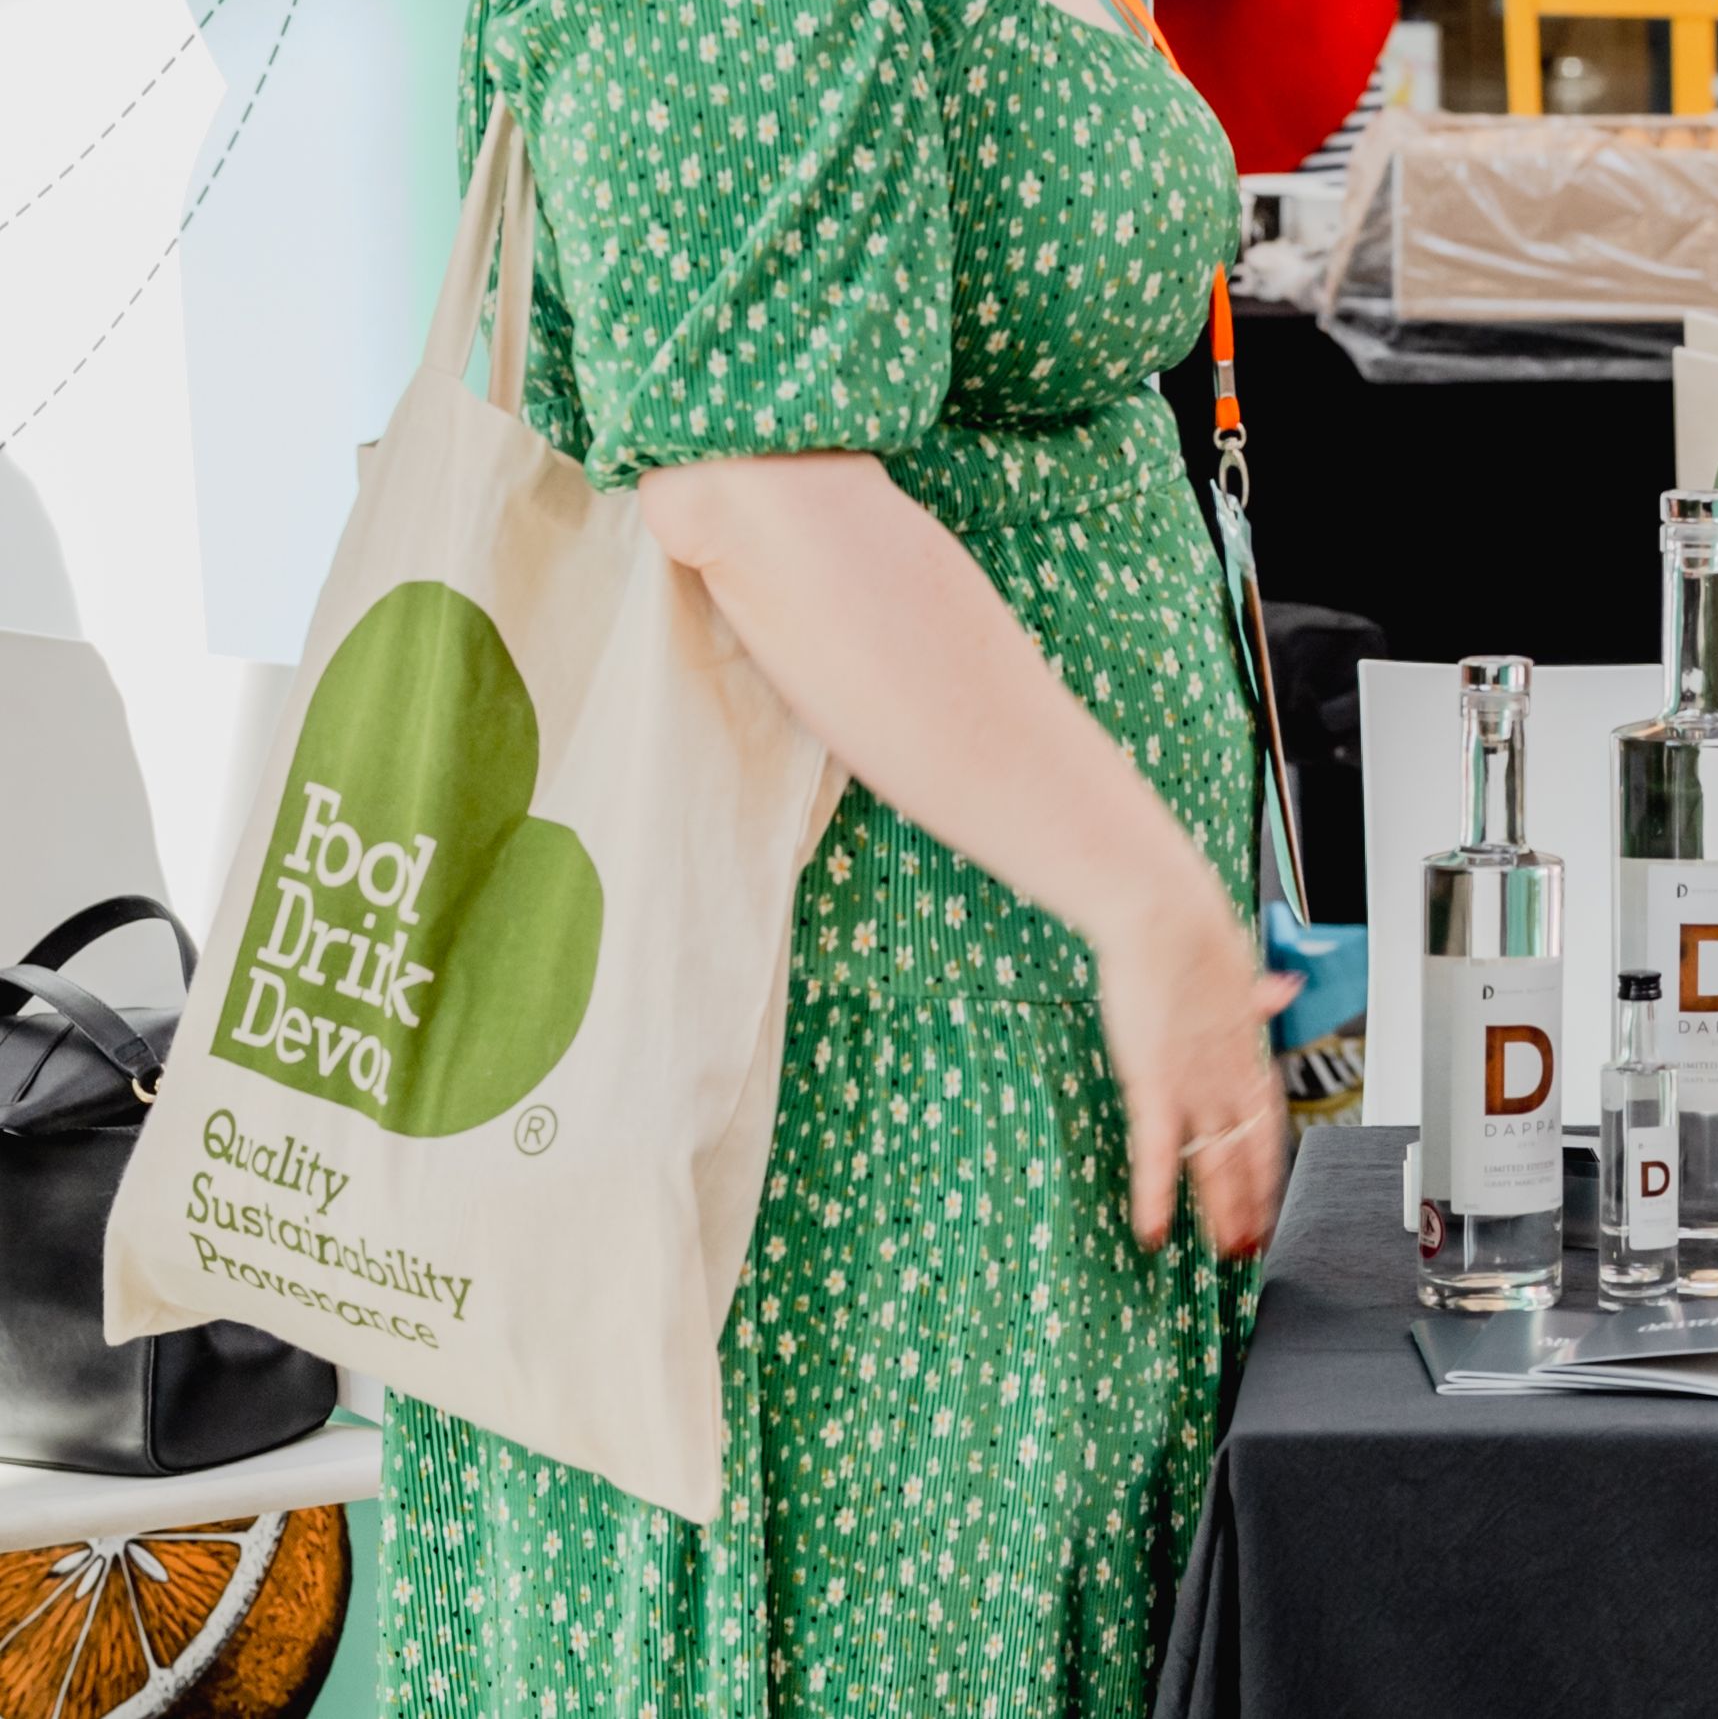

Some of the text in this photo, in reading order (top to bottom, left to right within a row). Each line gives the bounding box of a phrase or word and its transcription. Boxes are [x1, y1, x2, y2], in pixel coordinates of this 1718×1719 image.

[1485, 1025, 1554, 1117] D
[202, 1108, 350, 1215] Quality
[1484, 1119, 1556, 1138] DAPPA
[1640, 1161, 1671, 1198] D
[185, 1171, 473, 1321] Sustainability
[189, 1232, 440, 1349] Provenance
